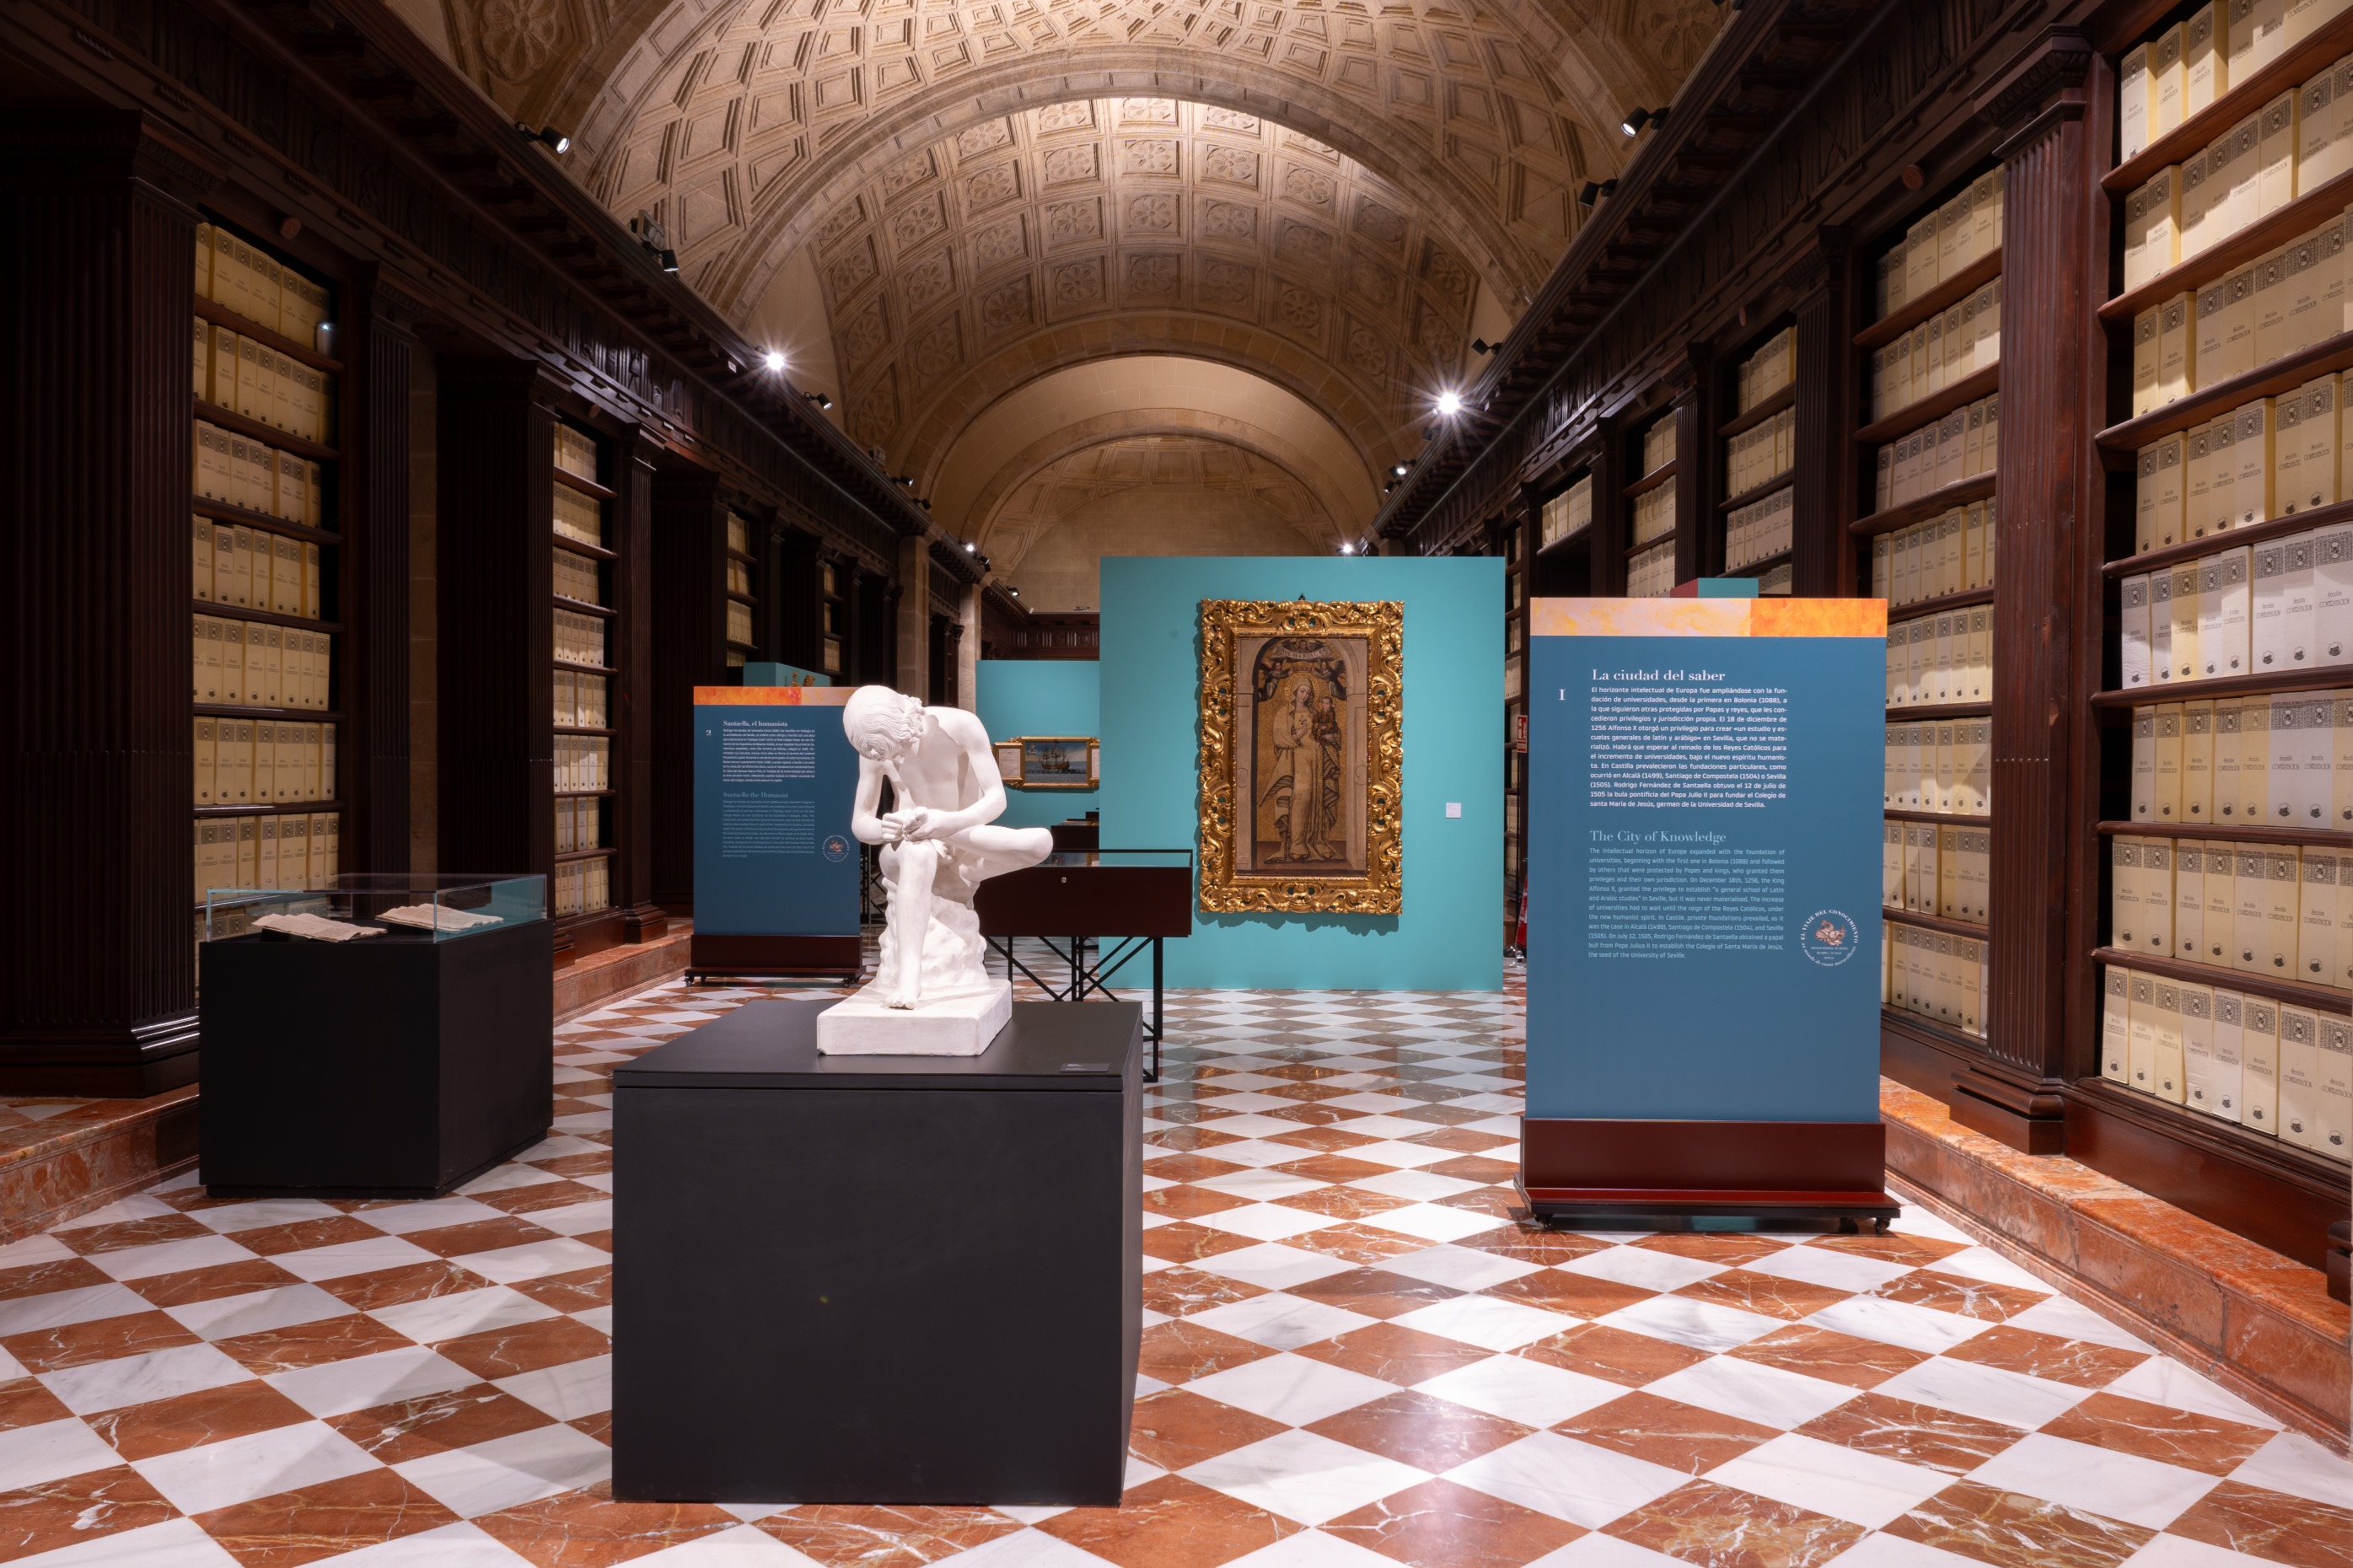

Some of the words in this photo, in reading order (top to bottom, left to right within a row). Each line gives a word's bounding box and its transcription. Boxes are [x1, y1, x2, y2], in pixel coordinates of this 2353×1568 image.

[1592, 669, 1609, 680] La
[1613, 669, 1659, 681] ciudad
[1663, 670, 1684, 681] del
[1688, 670, 1725, 681] saber
[1590, 830, 1613, 841] The
[1617, 830, 1641, 845] City
[1645, 831, 1658, 842] of
[1660, 831, 1726, 845] Knowledge
